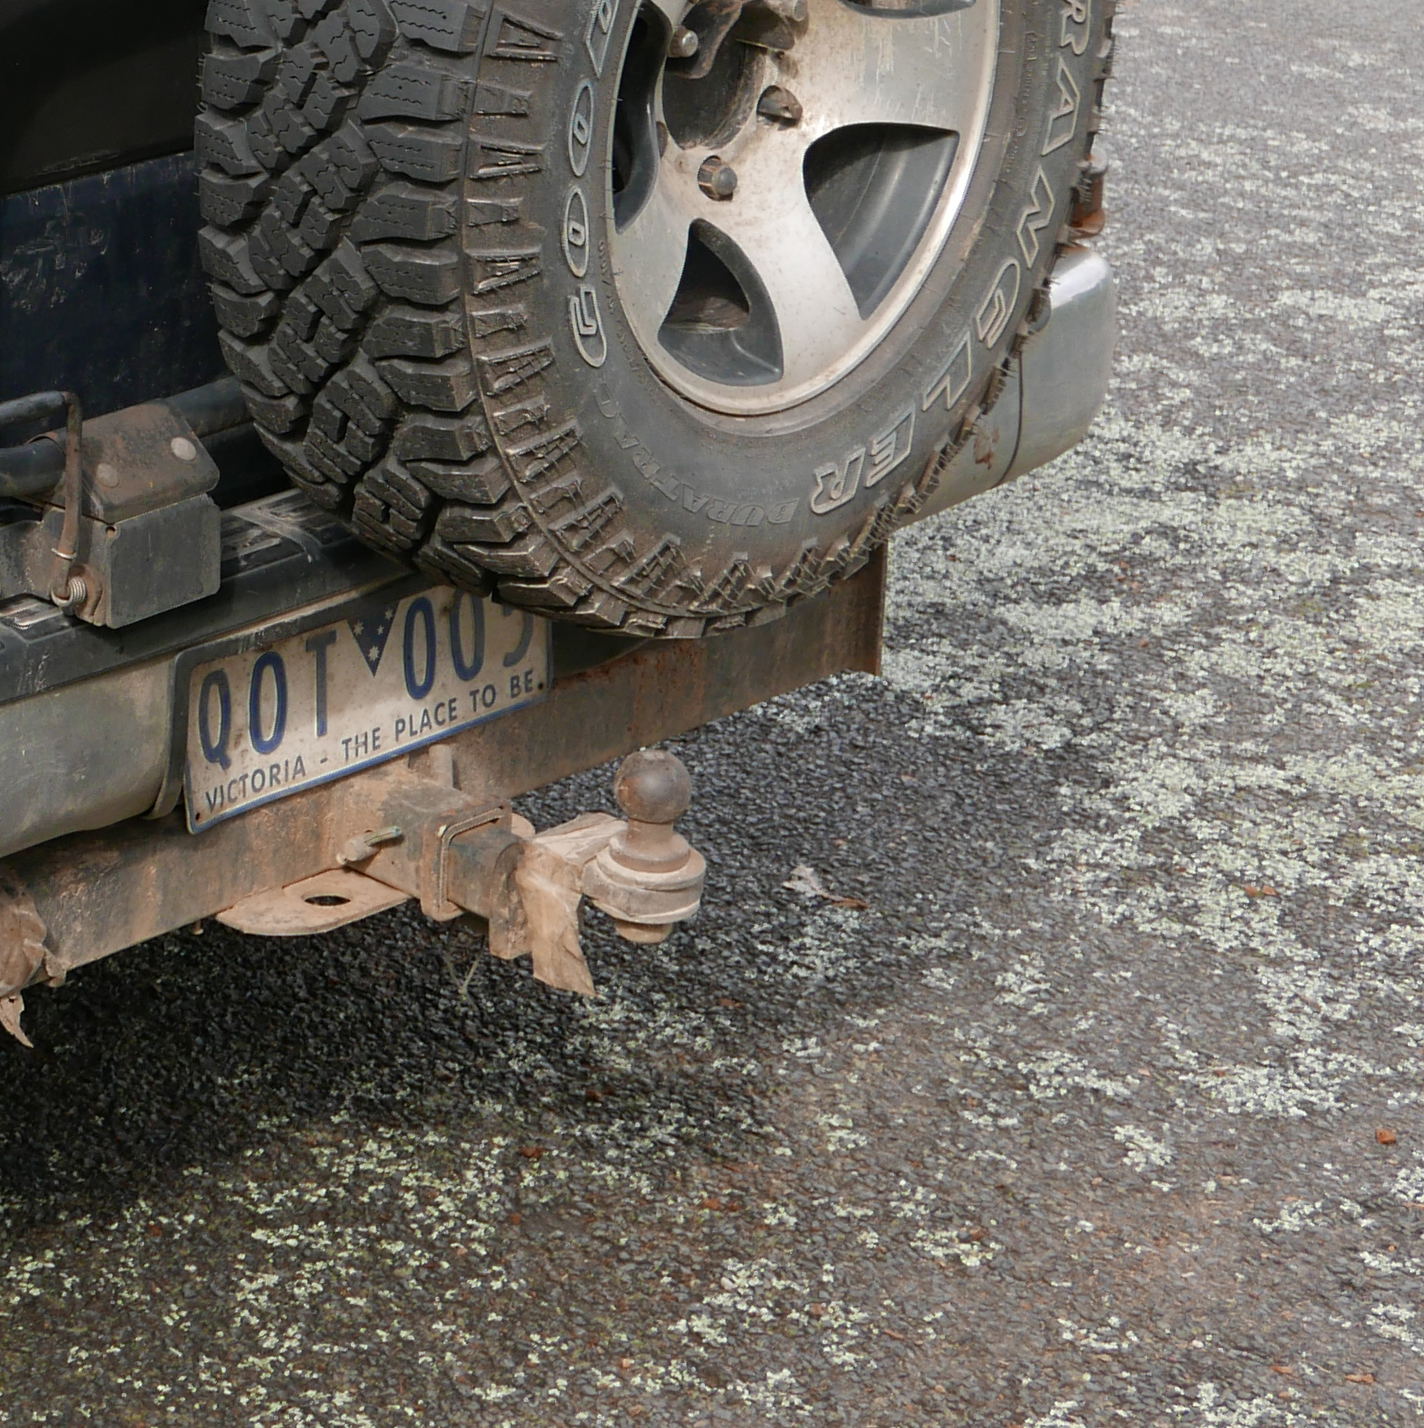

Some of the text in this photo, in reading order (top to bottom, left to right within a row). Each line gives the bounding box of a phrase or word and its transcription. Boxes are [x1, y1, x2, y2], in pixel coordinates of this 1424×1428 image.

[205, 755, 306, 813] VICTORIA
[341, 727, 381, 765] THE
[395, 697, 458, 743] PLACE
[469, 684, 496, 712] TO
